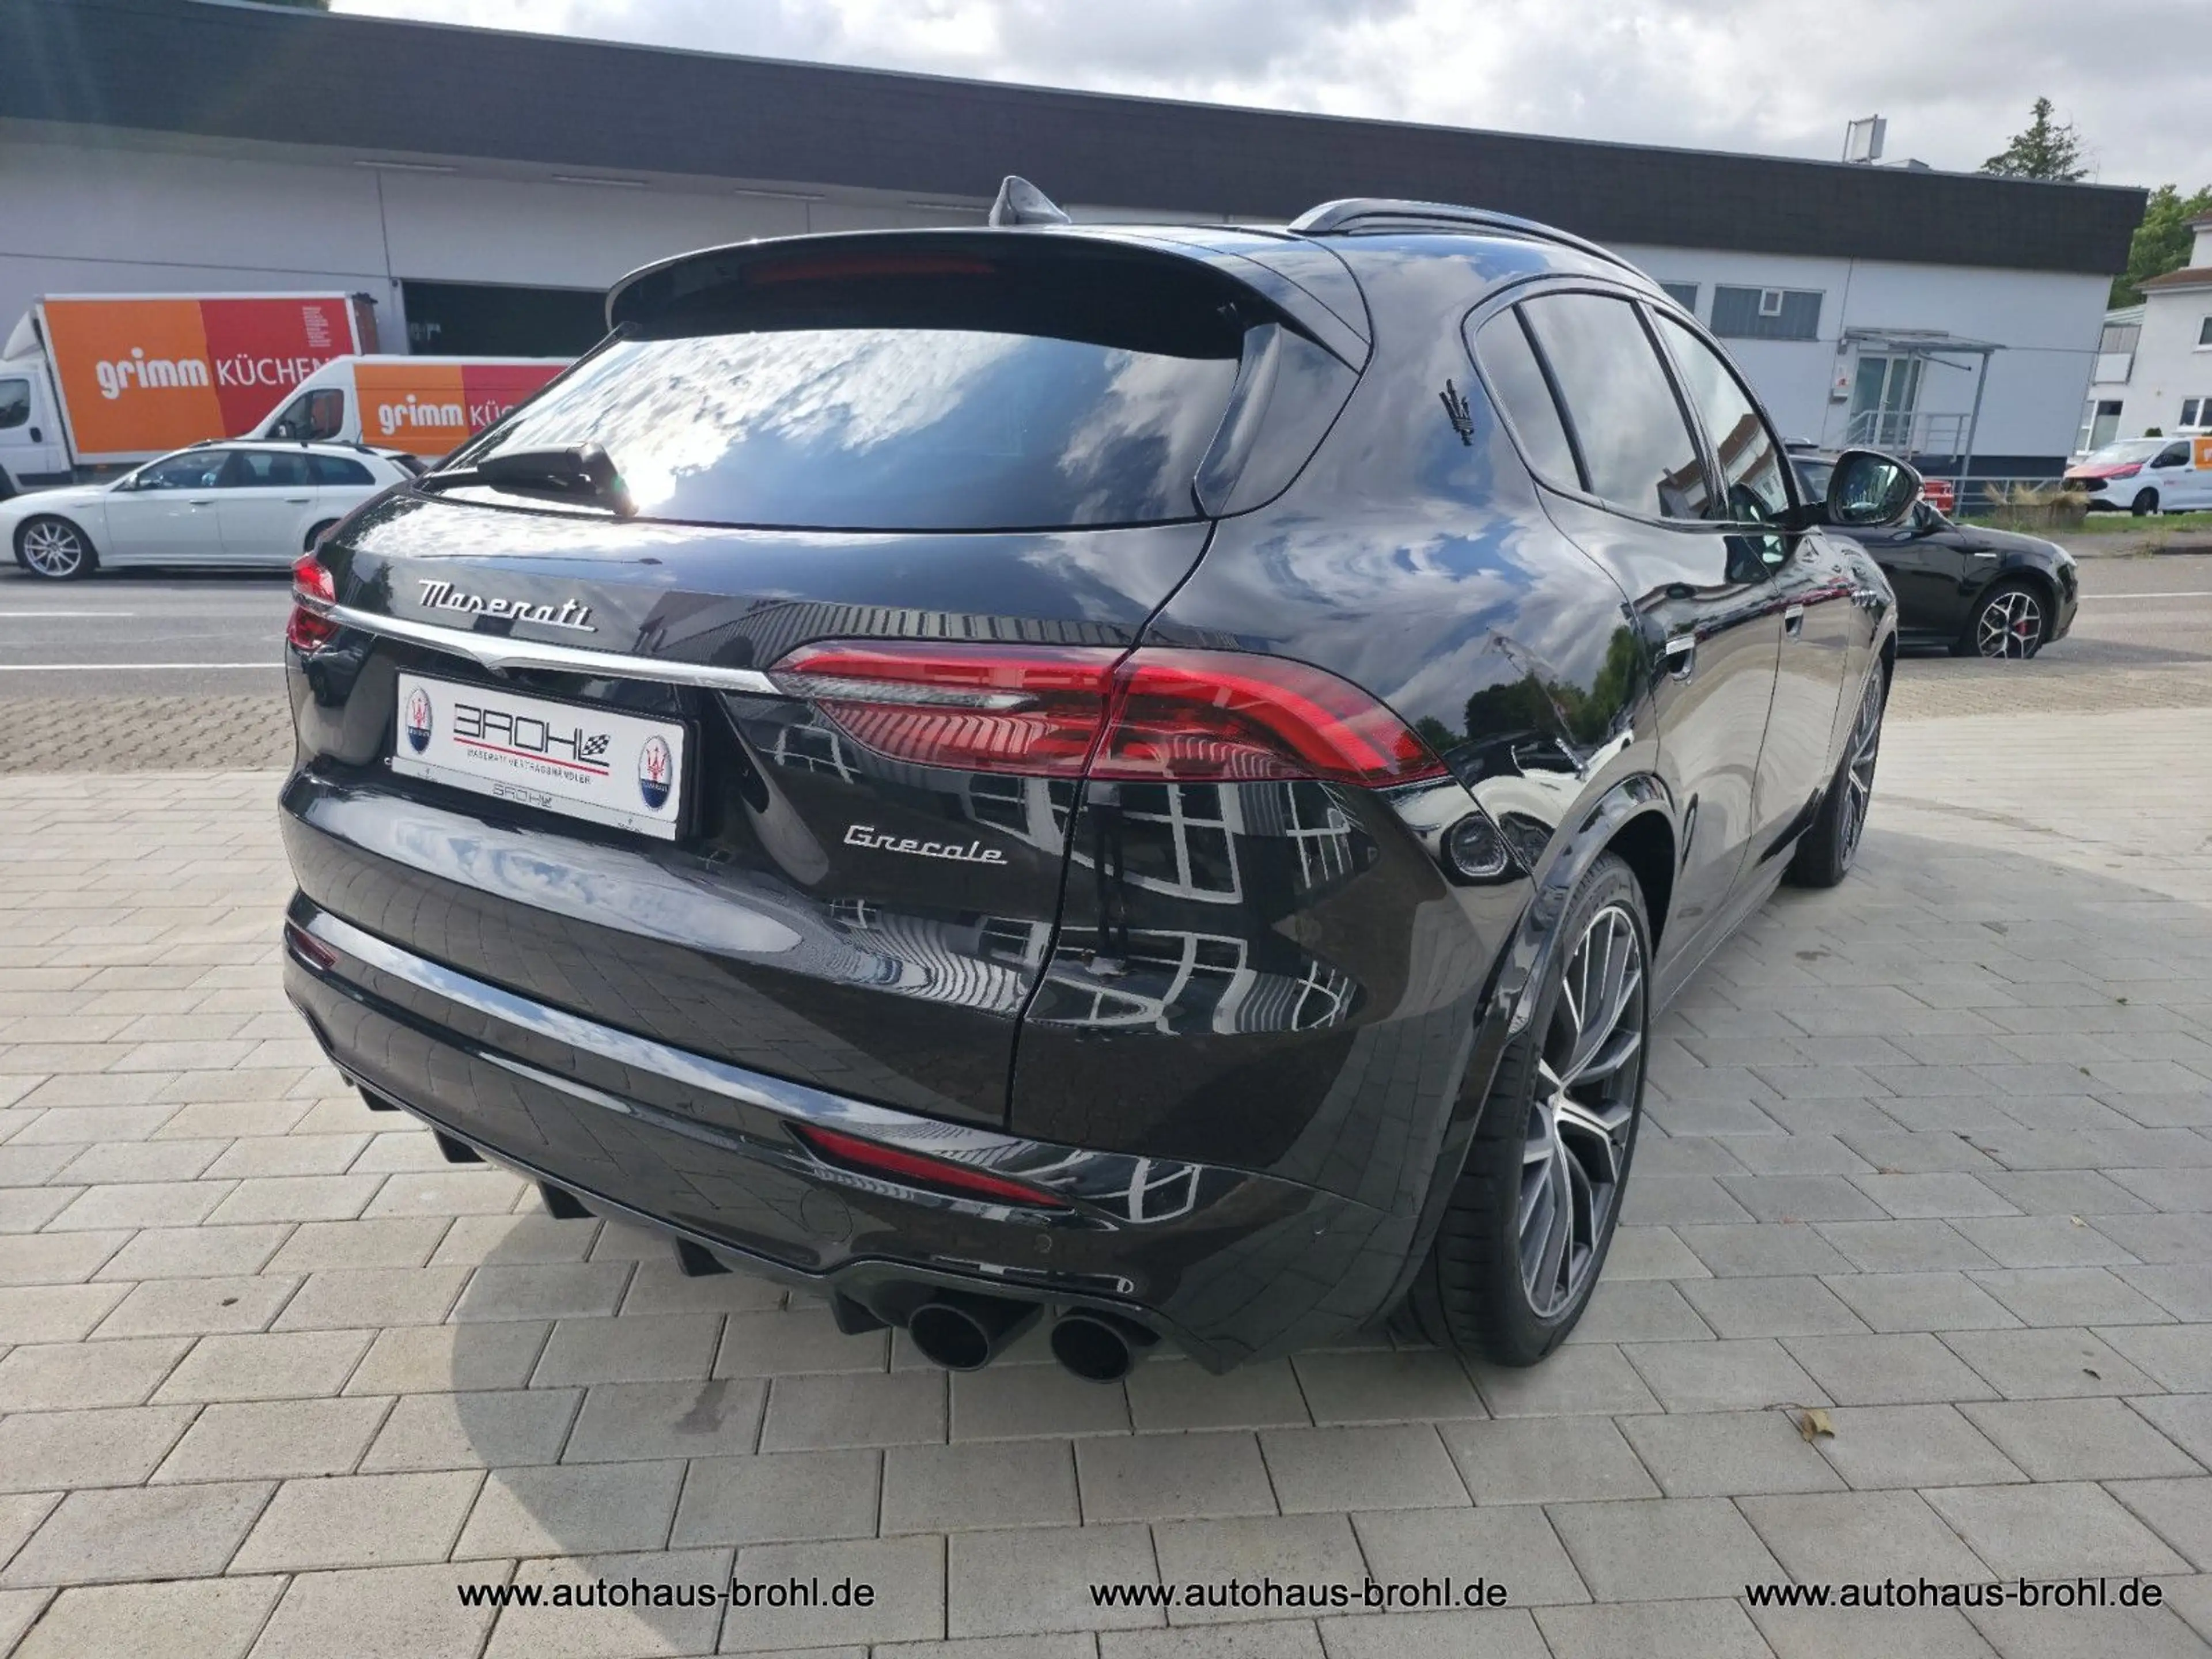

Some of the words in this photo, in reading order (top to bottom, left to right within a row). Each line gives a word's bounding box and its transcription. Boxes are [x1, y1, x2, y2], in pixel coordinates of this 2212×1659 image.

[96, 347, 209, 400] grimm
[378, 394, 464, 435] grimm
[418, 579, 599, 632] Maserati
[843, 825, 1008, 865] Grecale
